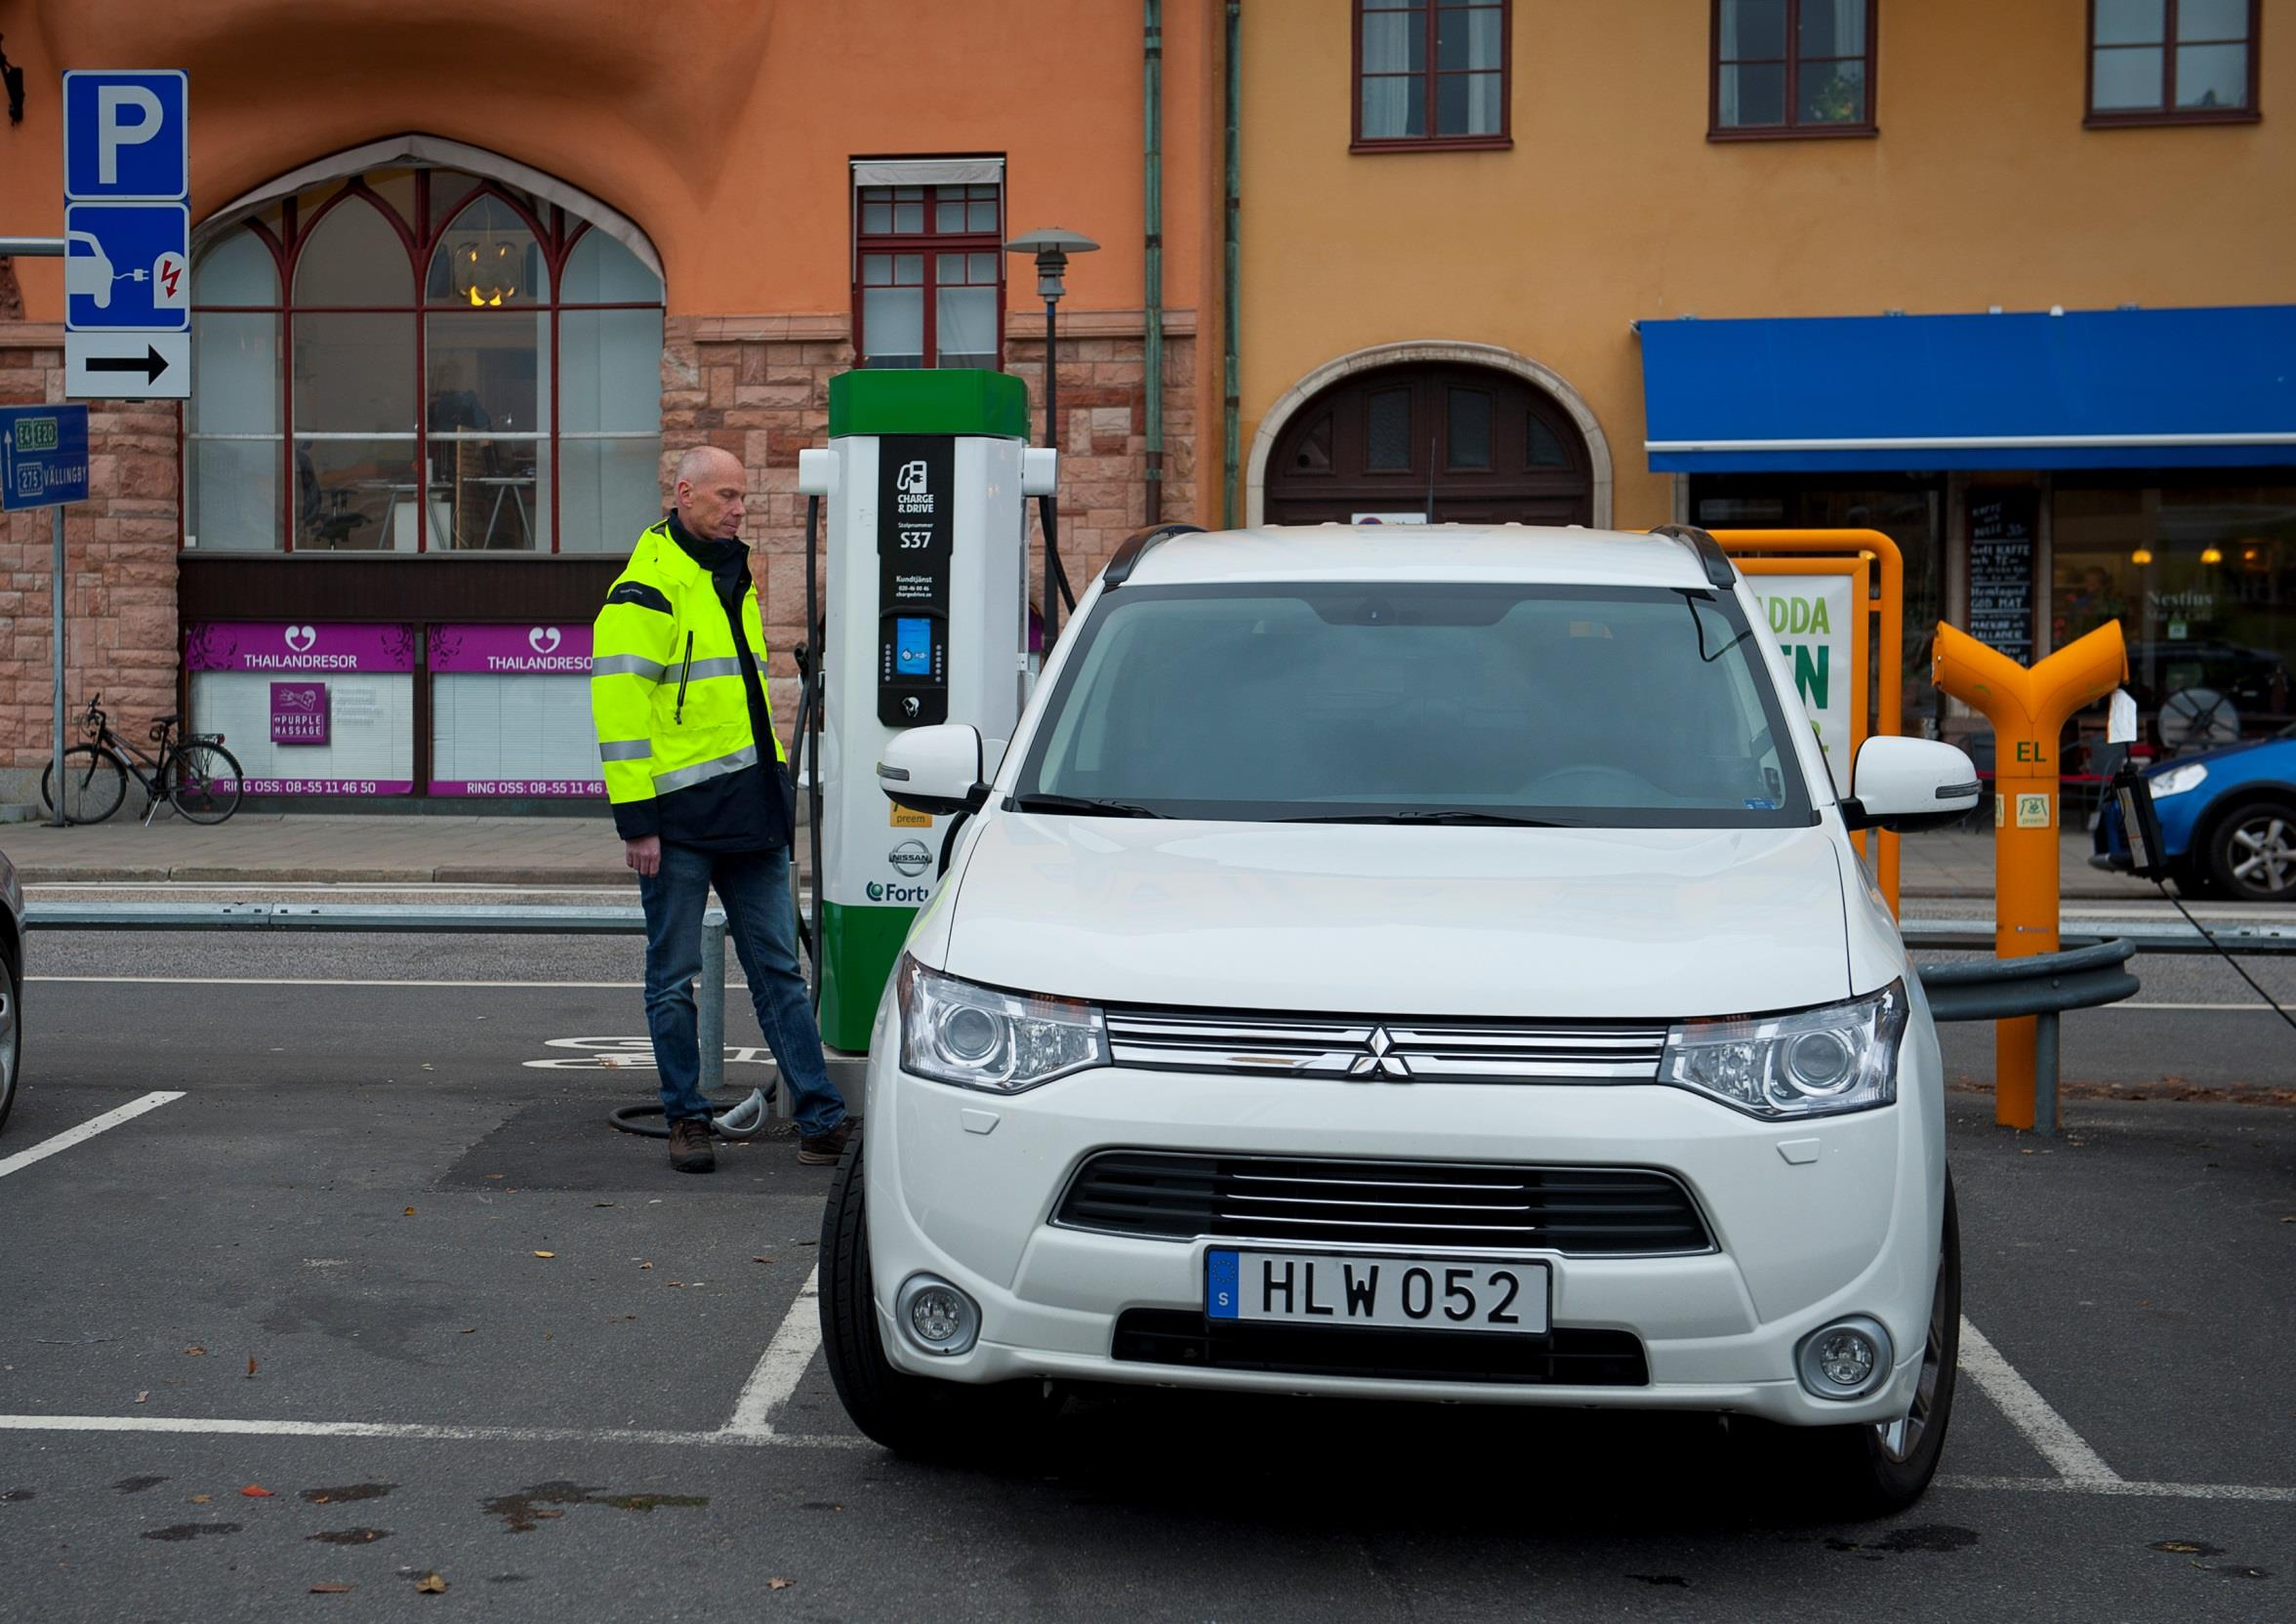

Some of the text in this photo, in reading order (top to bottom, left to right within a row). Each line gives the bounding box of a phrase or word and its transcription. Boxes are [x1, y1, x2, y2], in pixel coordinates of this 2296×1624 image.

[99, 85, 163, 183] P
[20, 425, 54, 445] E4 E20
[22, 466, 87, 489] 275 VÄLLINGBY
[897, 494, 934, 504] CHARGE
[898, 504, 934, 513] & DRIVE
[900, 532, 931, 548] S37
[896, 576, 932, 585] Kundtjänst
[244, 654, 357, 669] THAILANDRESOR
[487, 656, 593, 670] THAILANDRESO
[1781, 645, 1828, 710] N
[282, 714, 321, 724] PURPLE
[274, 725, 321, 735] MASSAGE
[2017, 742, 2046, 762] EL
[255, 781, 282, 792] OSS:
[286, 782, 322, 792] 08-55
[325, 782, 339, 792] 11
[342, 782, 357, 793] 46
[360, 782, 376, 793] 50
[467, 782, 602, 794] RING OSS: 08-55 11 46
[896, 814, 926, 825] preem
[1217, 1291, 1229, 1307] S
[1262, 1260, 1520, 1324] HLW 052
